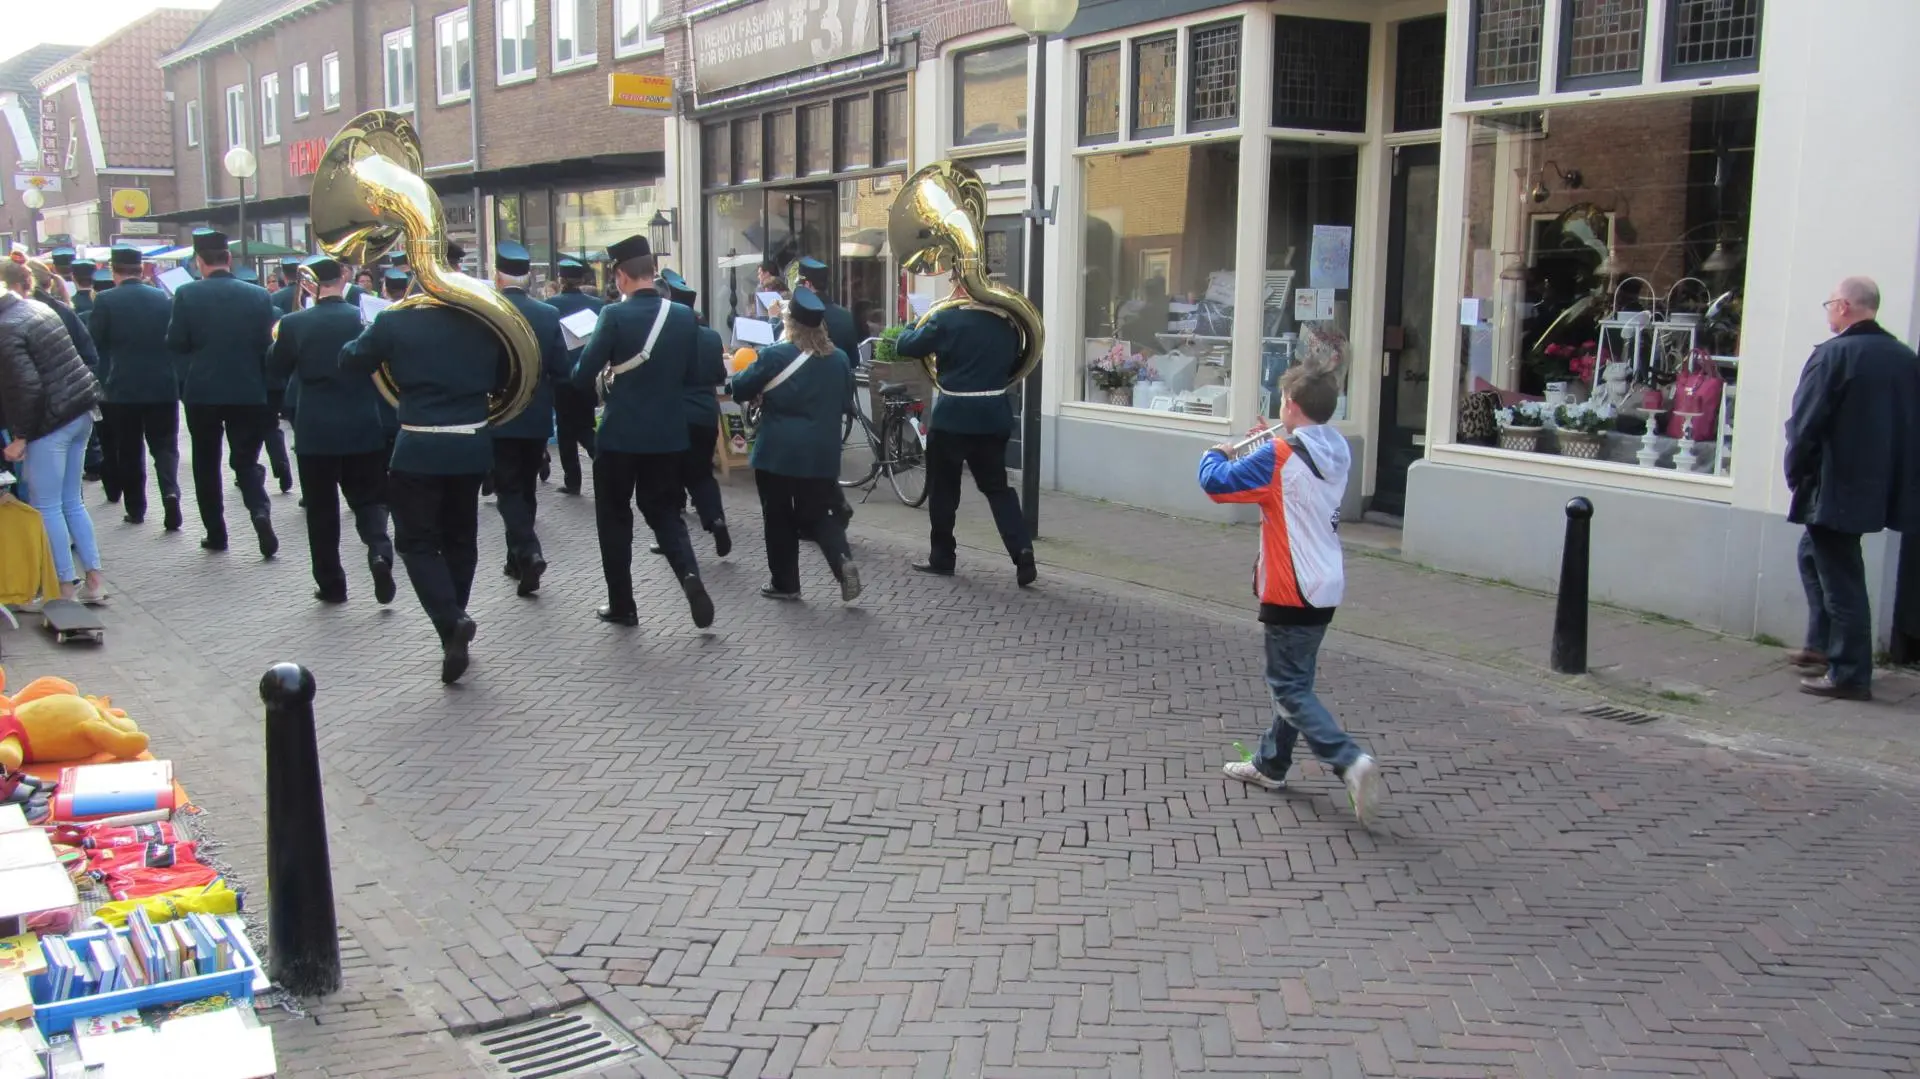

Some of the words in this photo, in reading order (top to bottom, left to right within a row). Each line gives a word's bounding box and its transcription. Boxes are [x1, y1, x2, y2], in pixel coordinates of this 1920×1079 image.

[700, 23, 737, 49] TRENDY
[738, 10, 785, 37] FASHION
[700, 50, 717, 68] FOR
[718, 44, 743, 63] BOYS
[743, 37, 764, 55] AND
[765, 29, 786, 49] MEN
